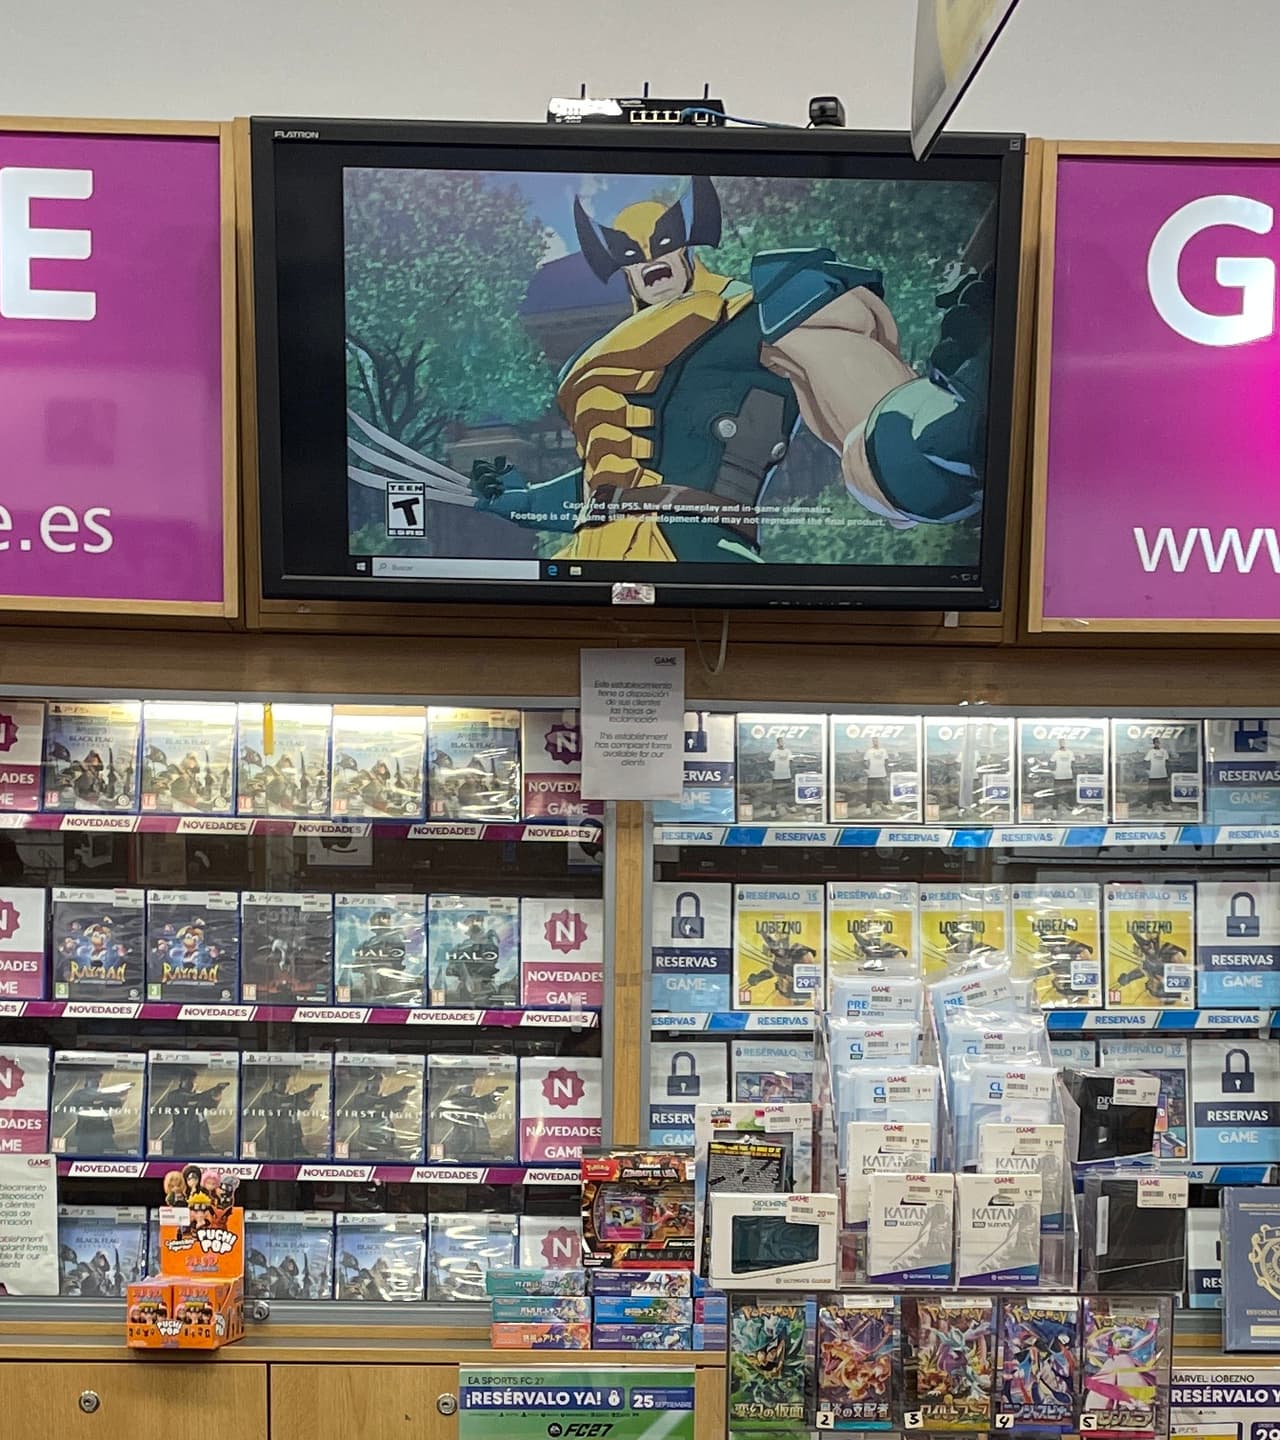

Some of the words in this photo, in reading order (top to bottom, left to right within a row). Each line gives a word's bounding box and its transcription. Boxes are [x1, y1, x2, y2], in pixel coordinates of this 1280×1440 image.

[392, 497, 420, 526] T
[674, 504, 719, 514] gameplay
[722, 504, 739, 512] and
[742, 505, 780, 515] in-game
[66, 817, 131, 829] NOVEDADES
[774, 830, 827, 842] RESERVAS
[444, 949, 499, 963] HALO
[1211, 953, 1274, 966] RESERVAS
[69, 961, 128, 984] RAYMAN
[1222, 974, 1263, 989] GAME
[197, 1229, 237, 1244] PUCHI
[202, 1238, 232, 1254] POP
[481, 1376, 517, 1385] SPORTS
[519, 1376, 533, 1385] FC
[535, 1376, 544, 1385] 27
[466, 1390, 570, 1408] ¡RESÉRVALO
[573, 1390, 601, 1406] YA!
[634, 1395, 653, 1408] 25
[564, 1423, 614, 1437] FC27
